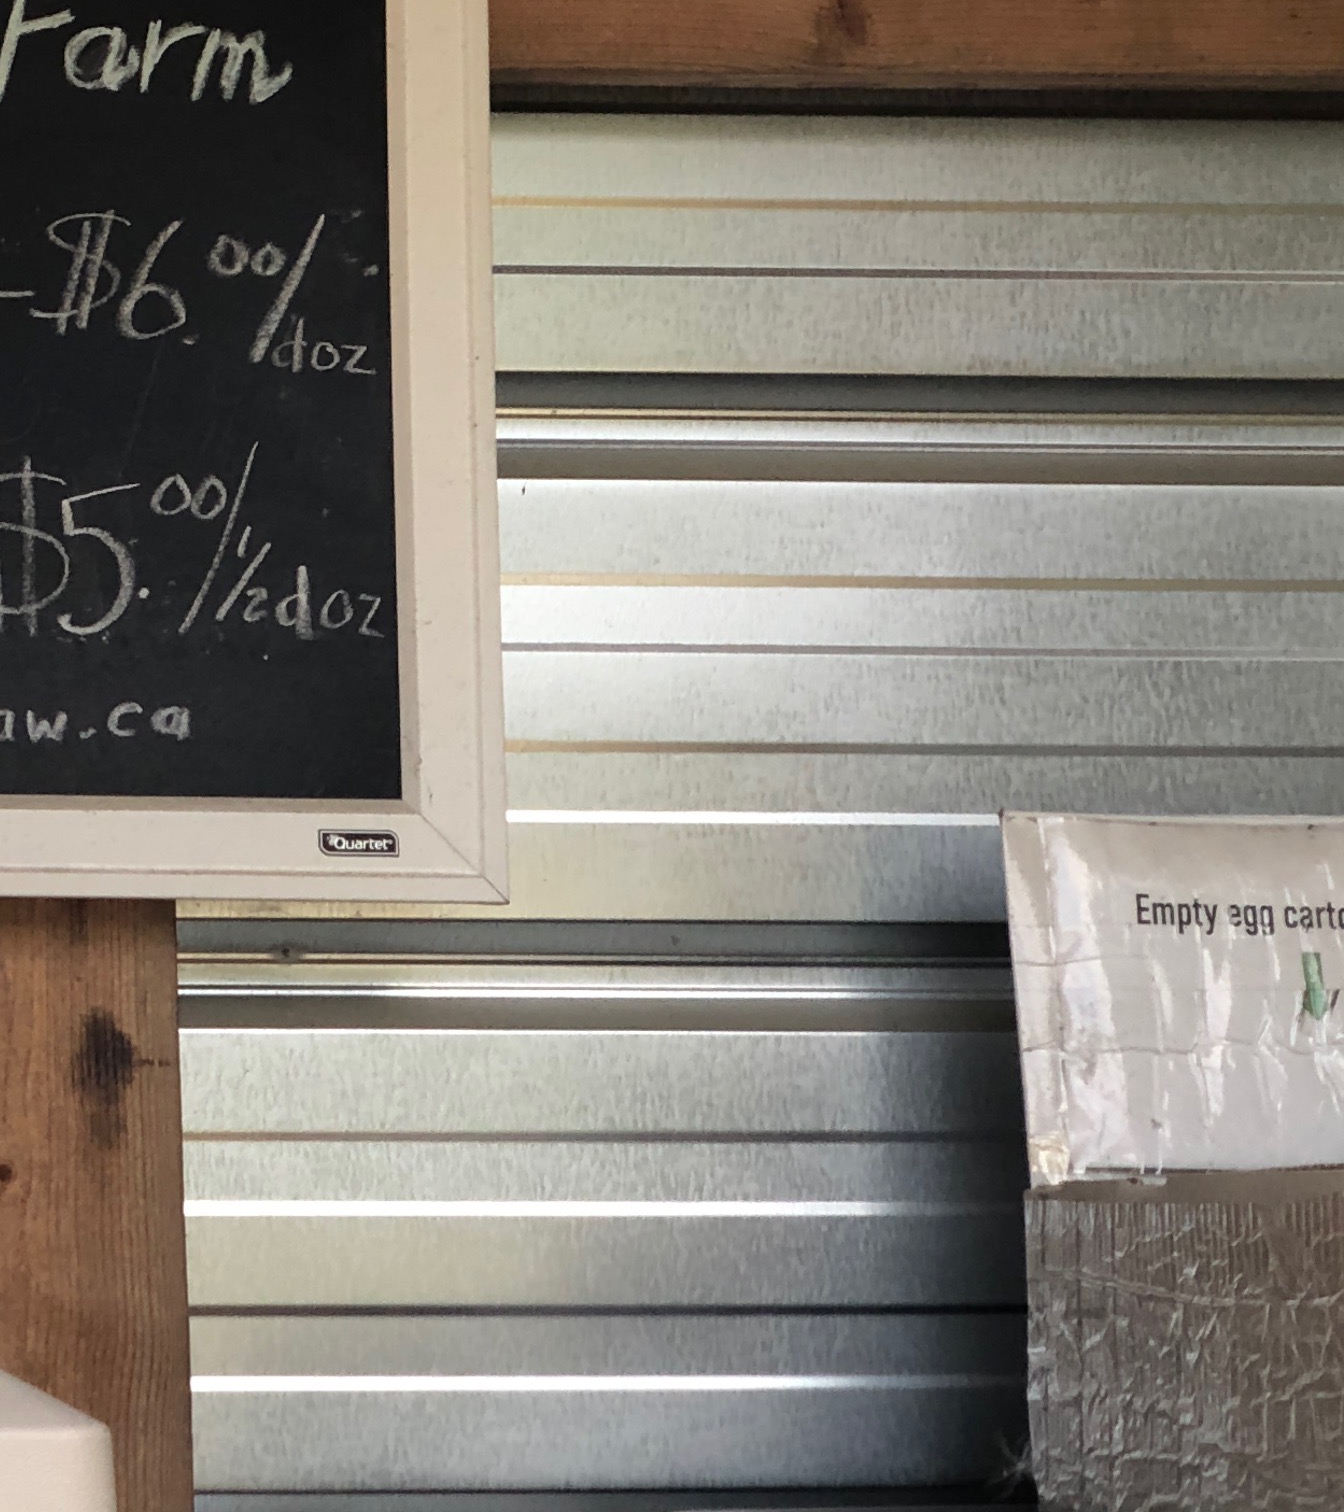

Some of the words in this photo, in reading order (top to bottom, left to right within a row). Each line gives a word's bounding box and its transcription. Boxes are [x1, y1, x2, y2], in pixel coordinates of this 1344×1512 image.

[334, 836, 389, 850] Quartet
[1135, 893, 1218, 935] Empty
[1228, 903, 1274, 935] egg
